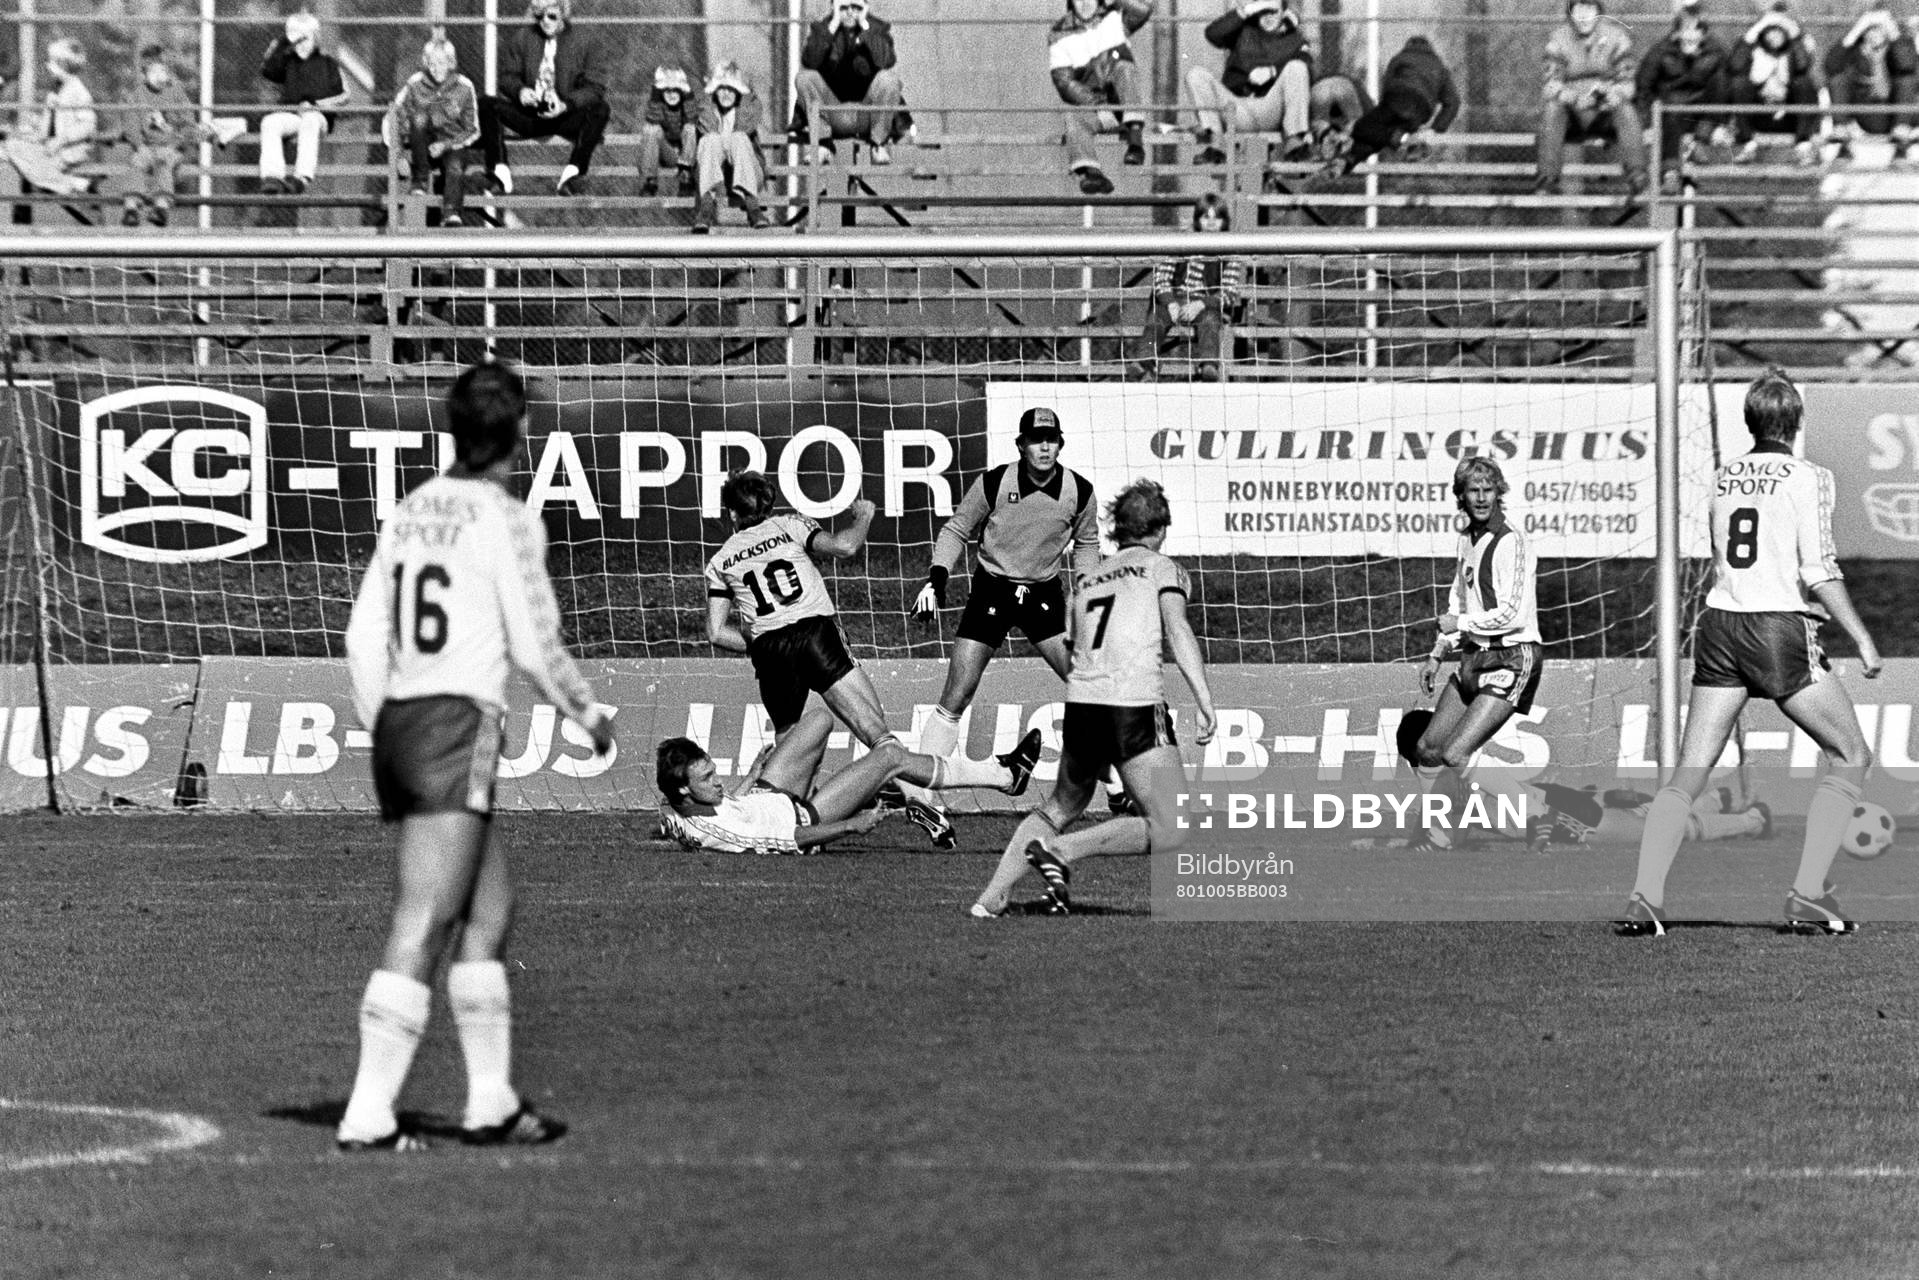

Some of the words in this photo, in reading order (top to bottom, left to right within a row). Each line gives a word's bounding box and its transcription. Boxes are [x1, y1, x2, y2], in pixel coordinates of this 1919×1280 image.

[1150, 428, 1648, 460] GULLRINGSHUS
[1227, 480, 1449, 503] RONNEBYKONTORET
[1524, 481, 1637, 502] 0457/16045
[1717, 478, 1782, 497] SPORT
[1524, 512, 1637, 534] 044/126120
[1726, 507, 1759, 569] 8
[392, 562, 452, 655] 16
[742, 558, 804, 617] 10
[1086, 593, 1116, 650] 7
